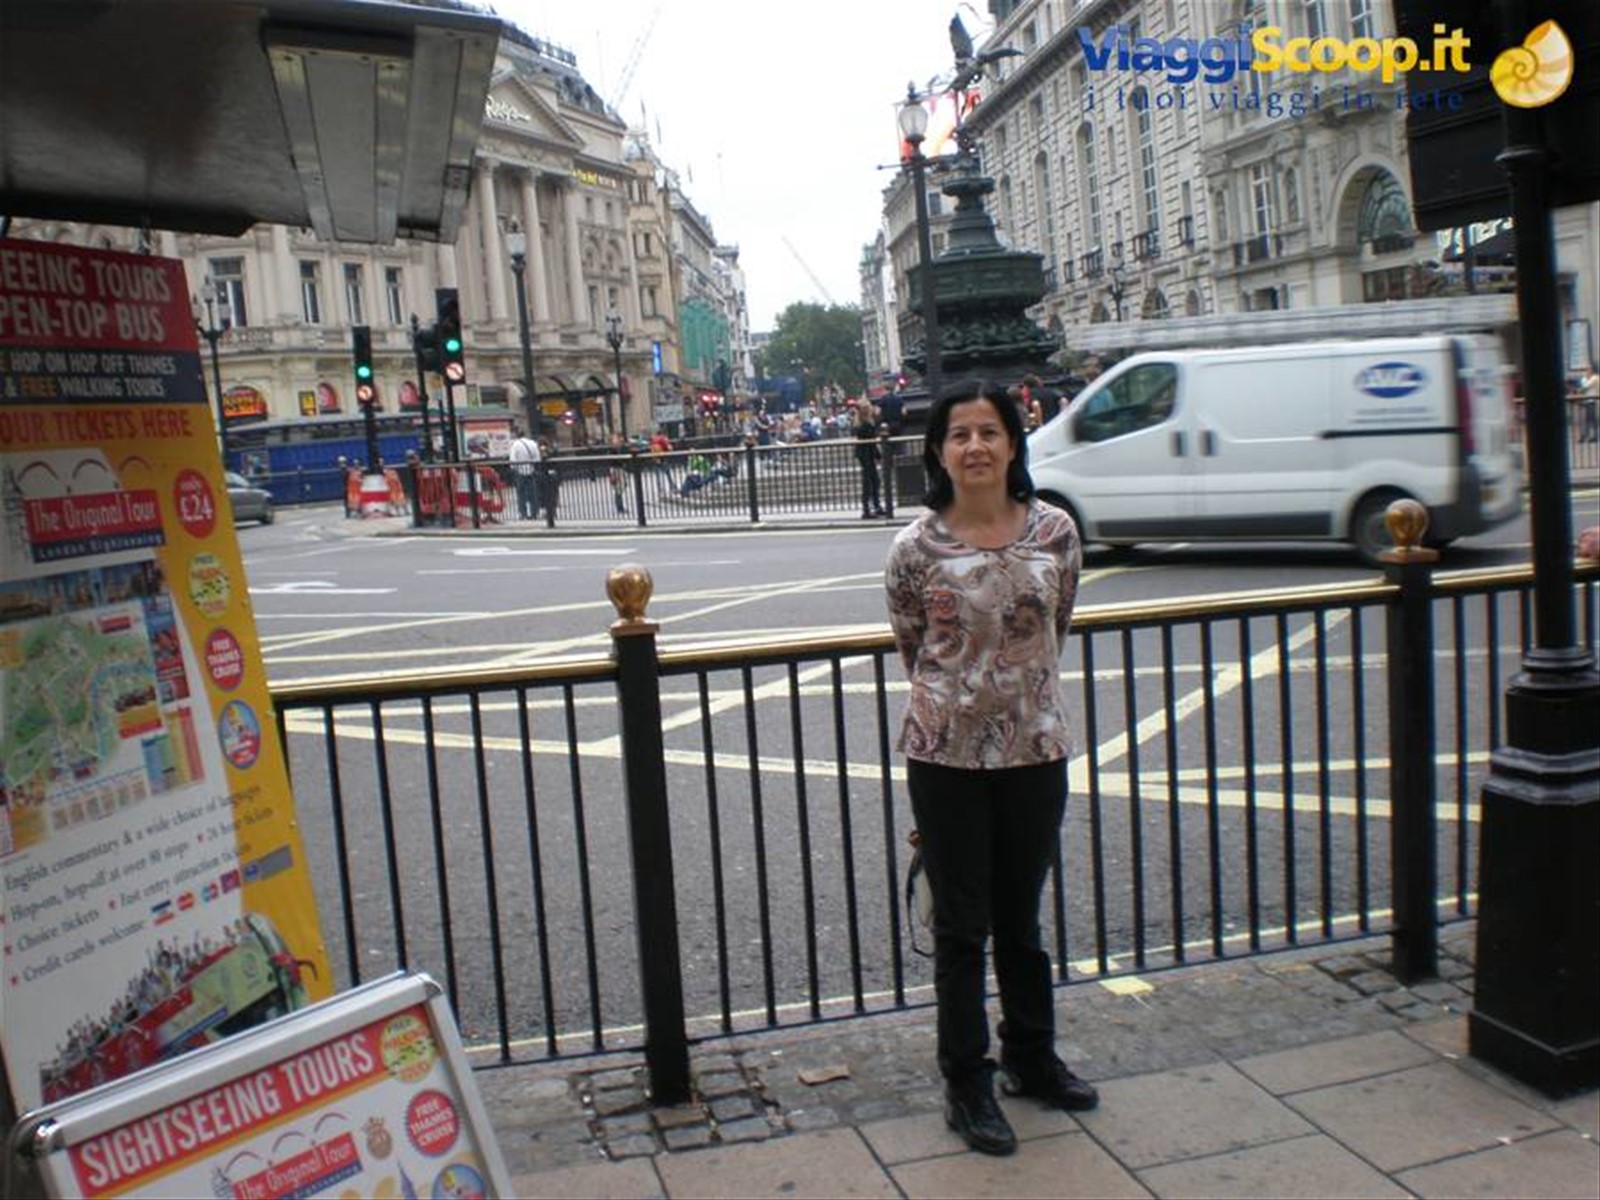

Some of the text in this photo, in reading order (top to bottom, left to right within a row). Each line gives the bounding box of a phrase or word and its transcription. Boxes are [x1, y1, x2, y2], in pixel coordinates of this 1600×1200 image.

[0, 249, 171, 303] EEING TOURS
[115, 303, 165, 343] BUS
[10, 351, 41, 372] HOP
[45, 352, 67, 373] ON
[69, 353, 98, 373] HOP
[101, 354, 126, 374] OFF
[127, 355, 177, 375] THAMES
[5, 377, 18, 398] &
[58, 377, 122, 397] WALKING
[124, 378, 166, 398] TOURS
[51, 409, 141, 442] TICKETS
[142, 407, 193, 438] HERE
[31, 493, 157, 535] The Original Tour
[5, 863, 49, 892] English
[23, 954, 61, 982] Credit
[64, 938, 96, 964] cards
[79, 1033, 375, 1188] SIGHTSEEING TOURS
[415, 1099, 441, 1118] FREE
[266, 1152, 322, 1194] Original
[323, 1138, 352, 1169] Tour
